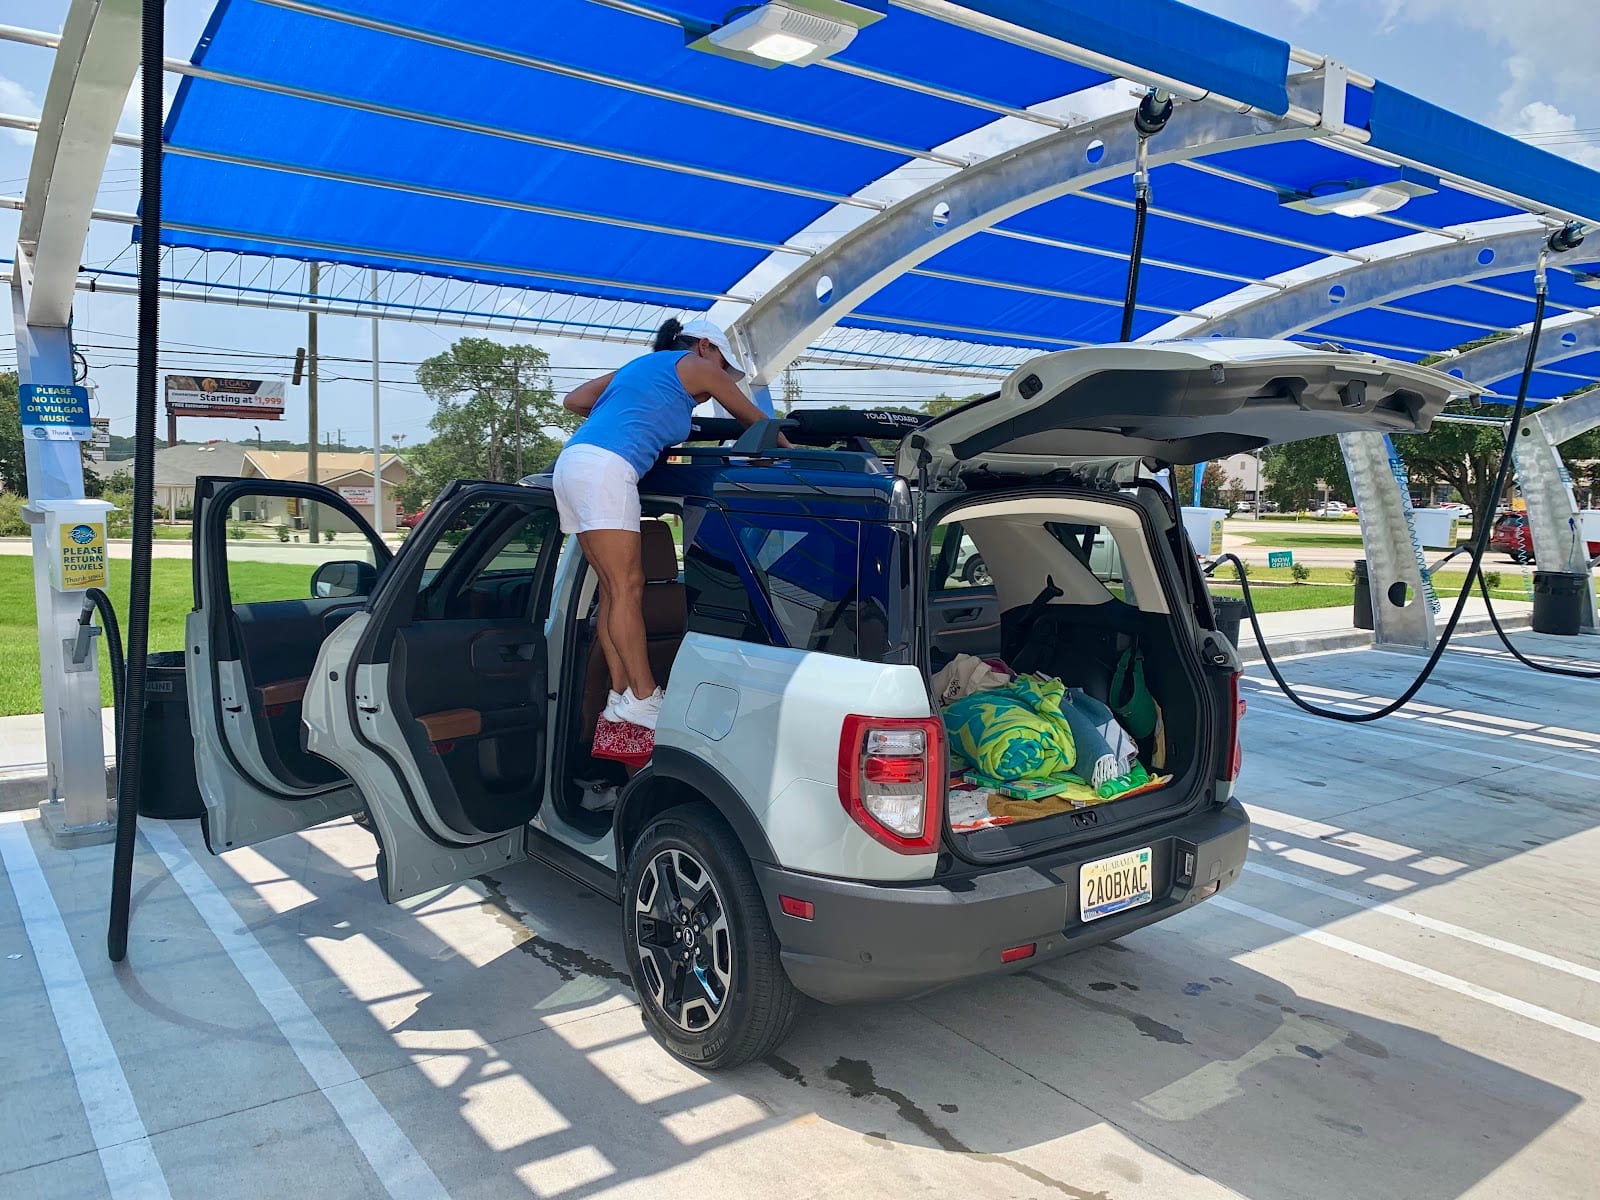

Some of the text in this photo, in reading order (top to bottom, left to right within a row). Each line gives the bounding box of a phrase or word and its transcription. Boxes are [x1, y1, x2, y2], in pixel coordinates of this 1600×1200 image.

[220, 379, 252, 388] LEGACY
[36, 387, 72, 395] PLEASE
[200, 393, 282, 405] Starting at $1,999
[43, 406, 84, 414] VULGAR
[39, 414, 74, 423] MUSIC.
[863, 412, 918, 423] YOLO BOARD
[63, 546, 103, 555] PLEASE
[63, 555, 103, 564] RETURN
[64, 563, 104, 571] TOWELS
[1101, 857, 1134, 871] ALABAMA
